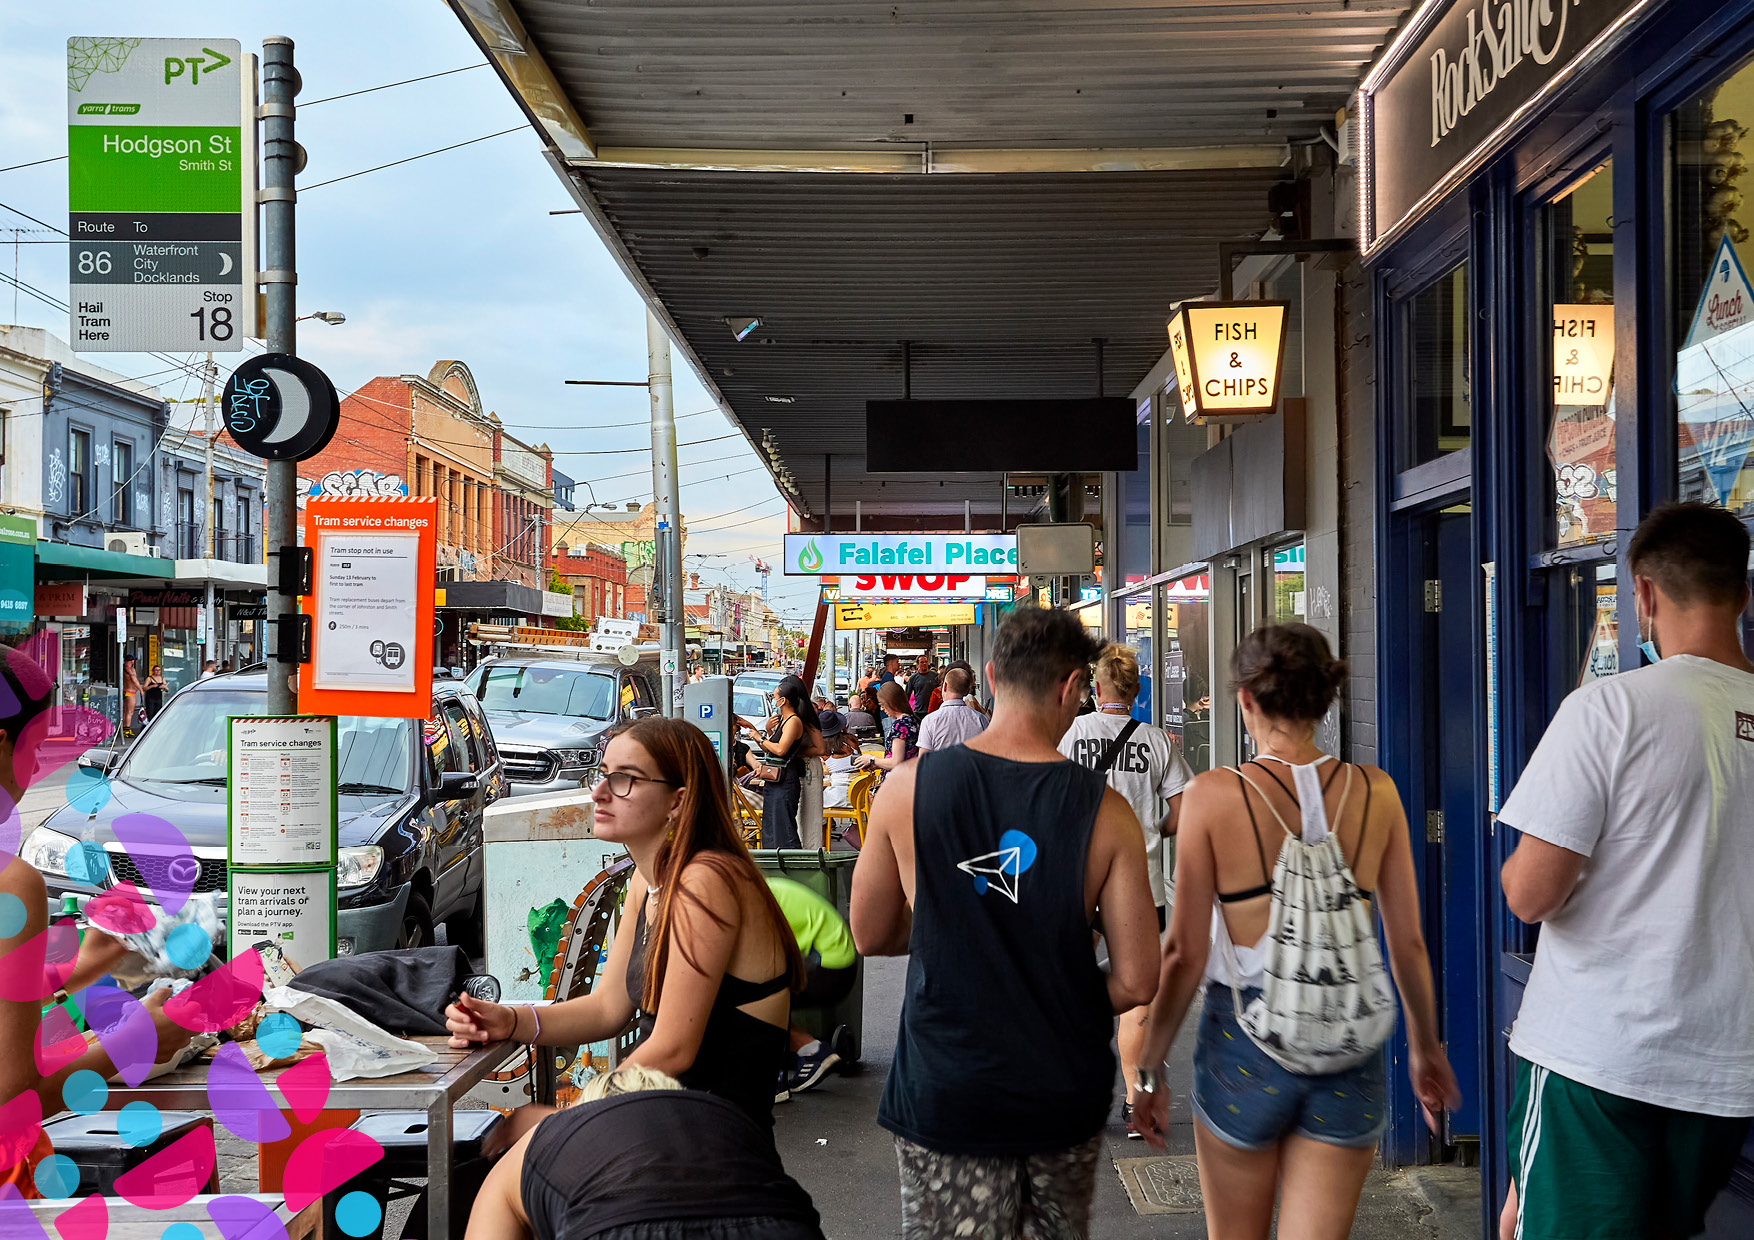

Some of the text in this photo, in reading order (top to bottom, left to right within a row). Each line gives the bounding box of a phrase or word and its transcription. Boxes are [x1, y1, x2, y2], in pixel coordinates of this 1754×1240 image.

[82, 104, 136, 113] yarra trams
[103, 134, 232, 158] Hodgson St
[179, 160, 232, 172] Smith St
[77, 221, 148, 233] Route To
[133, 244, 199, 256] Waterfront
[77, 250, 112, 275] 86
[133, 258, 159, 272] City
[134, 271, 200, 284] Docklands
[203, 290, 232, 304] Stop
[78, 301, 103, 314] Hail
[1706, 289, 1744, 330] Lunch
[78, 316, 111, 327] Tram
[190, 306, 234, 342] 18
[78, 330, 110, 341] Here
[1215, 322, 1257, 341] FISH
[1229, 352, 1243, 368] &
[1205, 377, 1268, 397] CHIPS
[313, 514, 428, 530] Tram service changes
[330, 546, 347, 554] Tram
[347, 547, 361, 557] stop
[839, 541, 1017, 565] Falafel Place
[130, 591, 163, 604] Pearl
[162, 590, 191, 606] Nails
[701, 705, 711, 718] P
[240, 739, 322, 748] Tram service changes
[237, 886, 306, 897] View your next
[238, 896, 309, 906] tram arrivals or
[237, 907, 256, 917] plan
[264, 908, 303, 918] journey.
